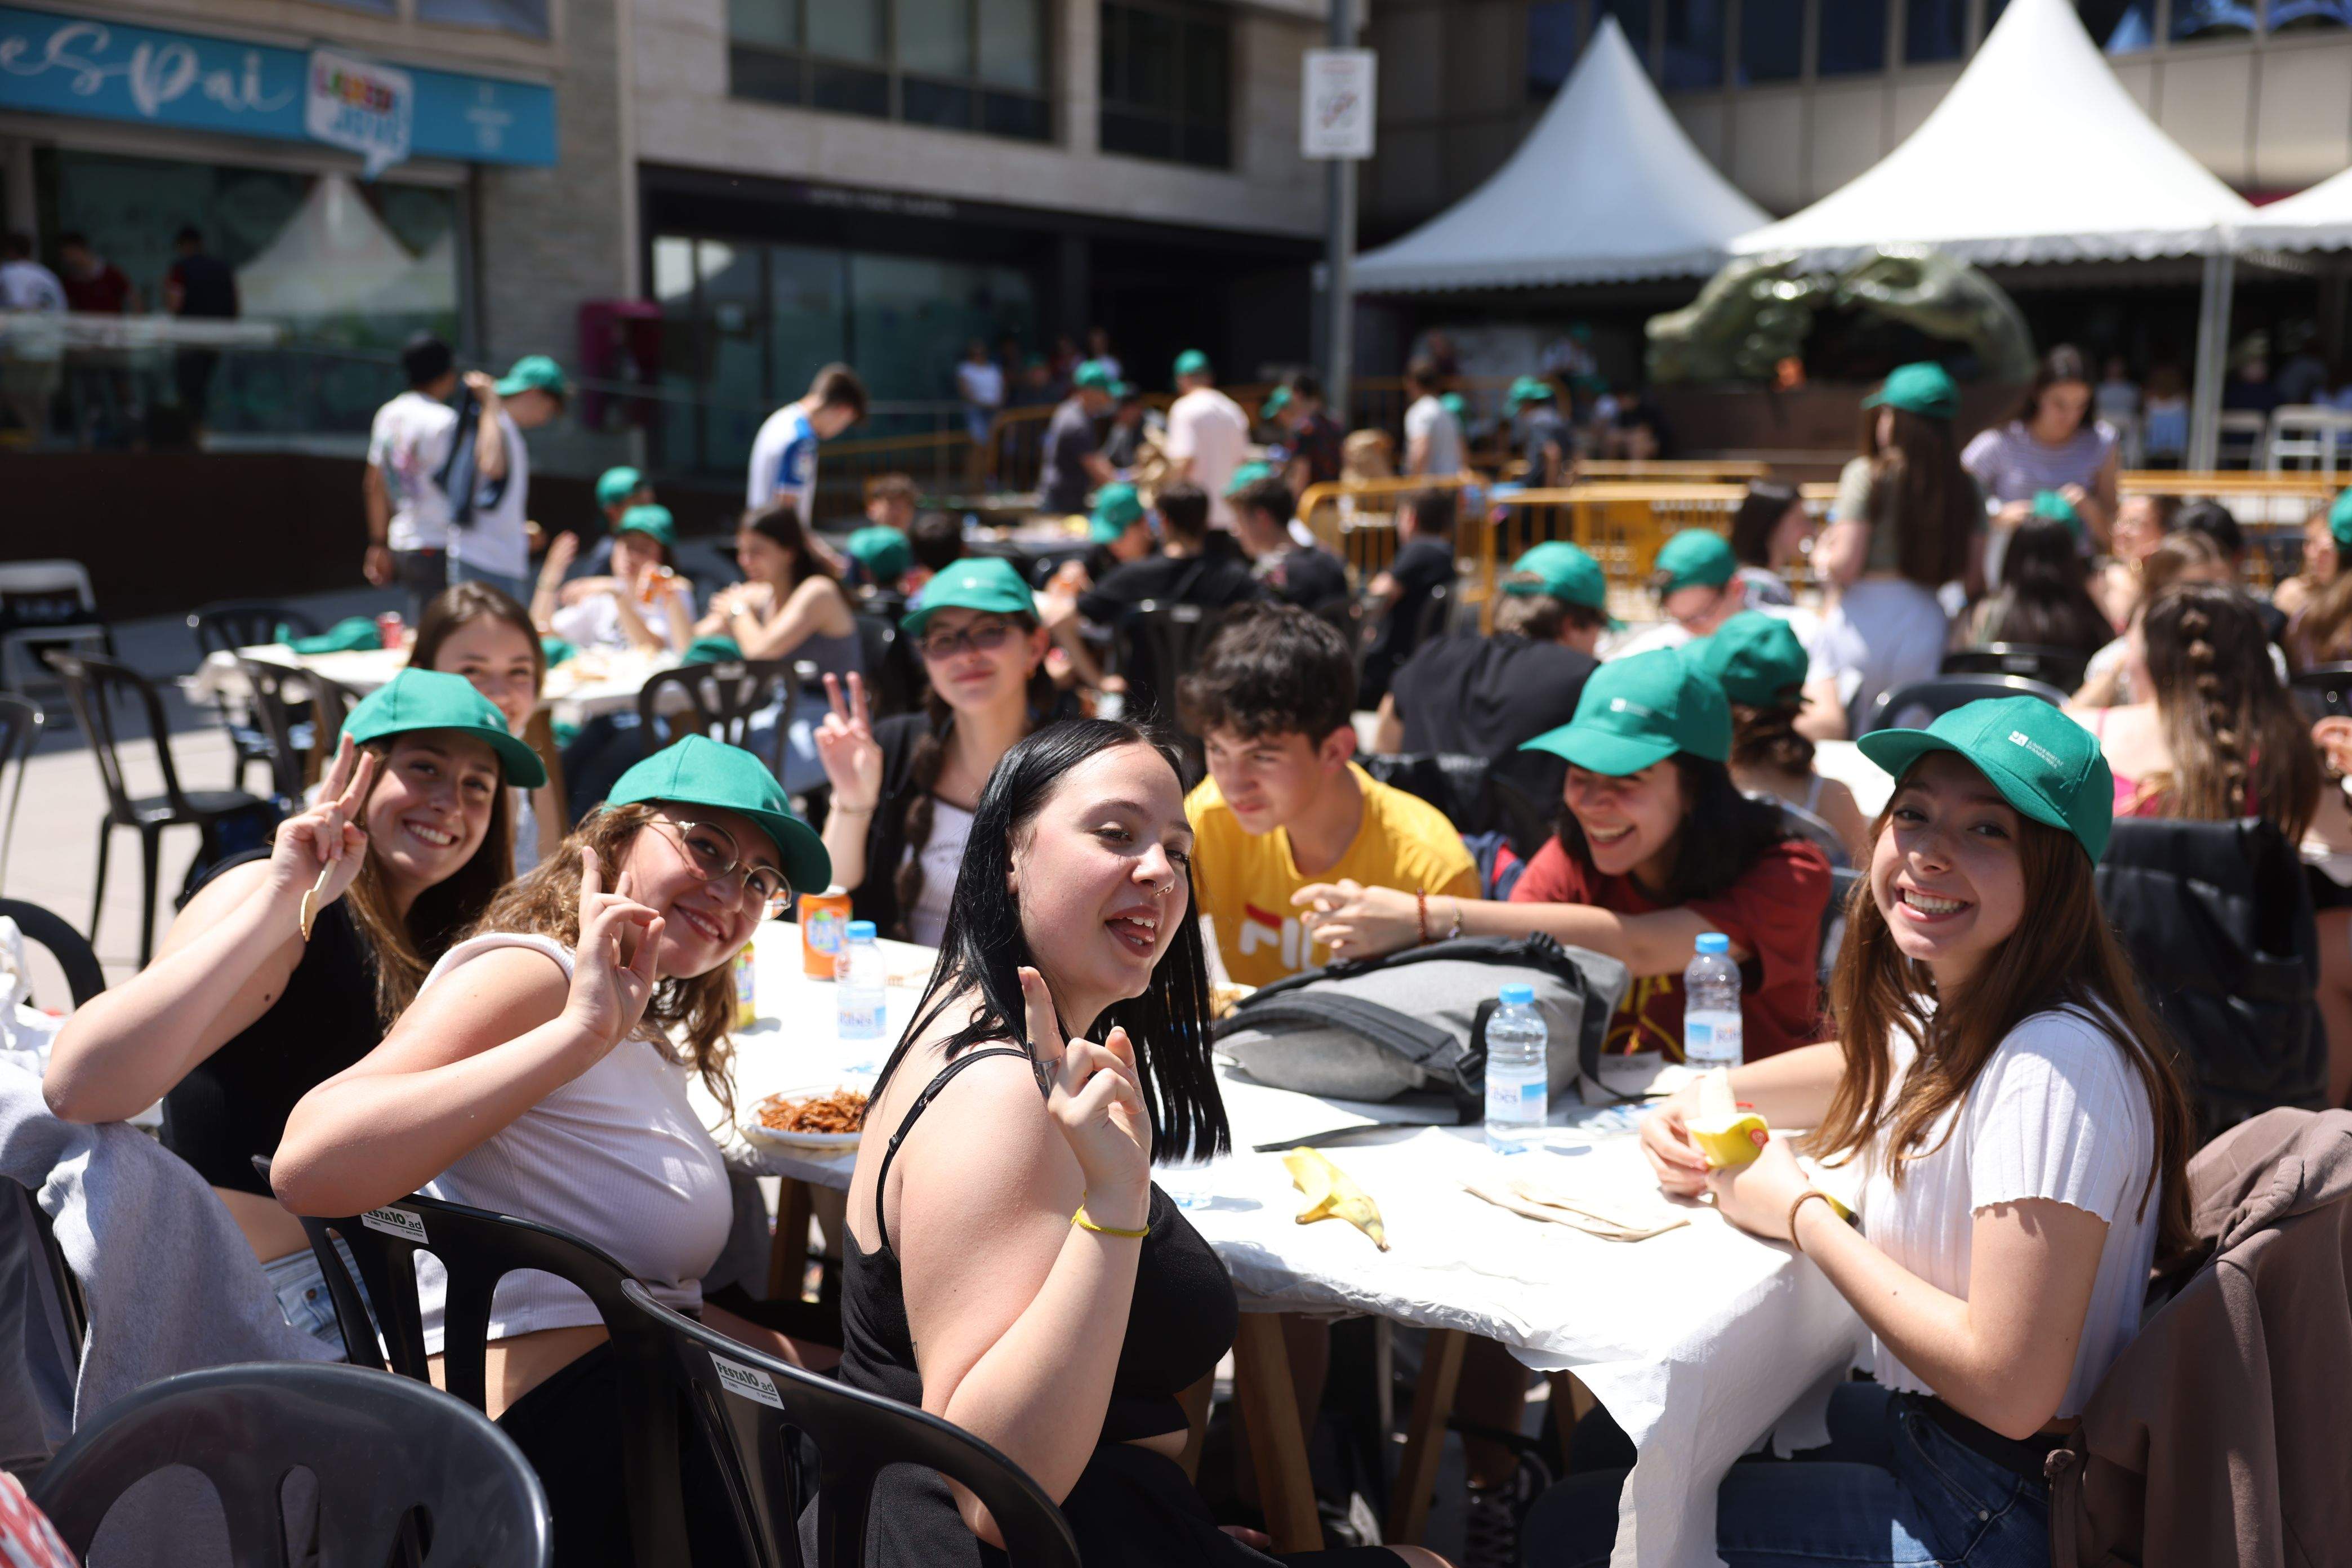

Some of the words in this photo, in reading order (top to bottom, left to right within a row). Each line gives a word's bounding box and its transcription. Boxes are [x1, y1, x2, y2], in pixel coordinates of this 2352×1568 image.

[1240, 900, 1350, 972] FIL
[364, 1211, 406, 1225] ESTA10
[716, 1361, 759, 1387] FESTA10
